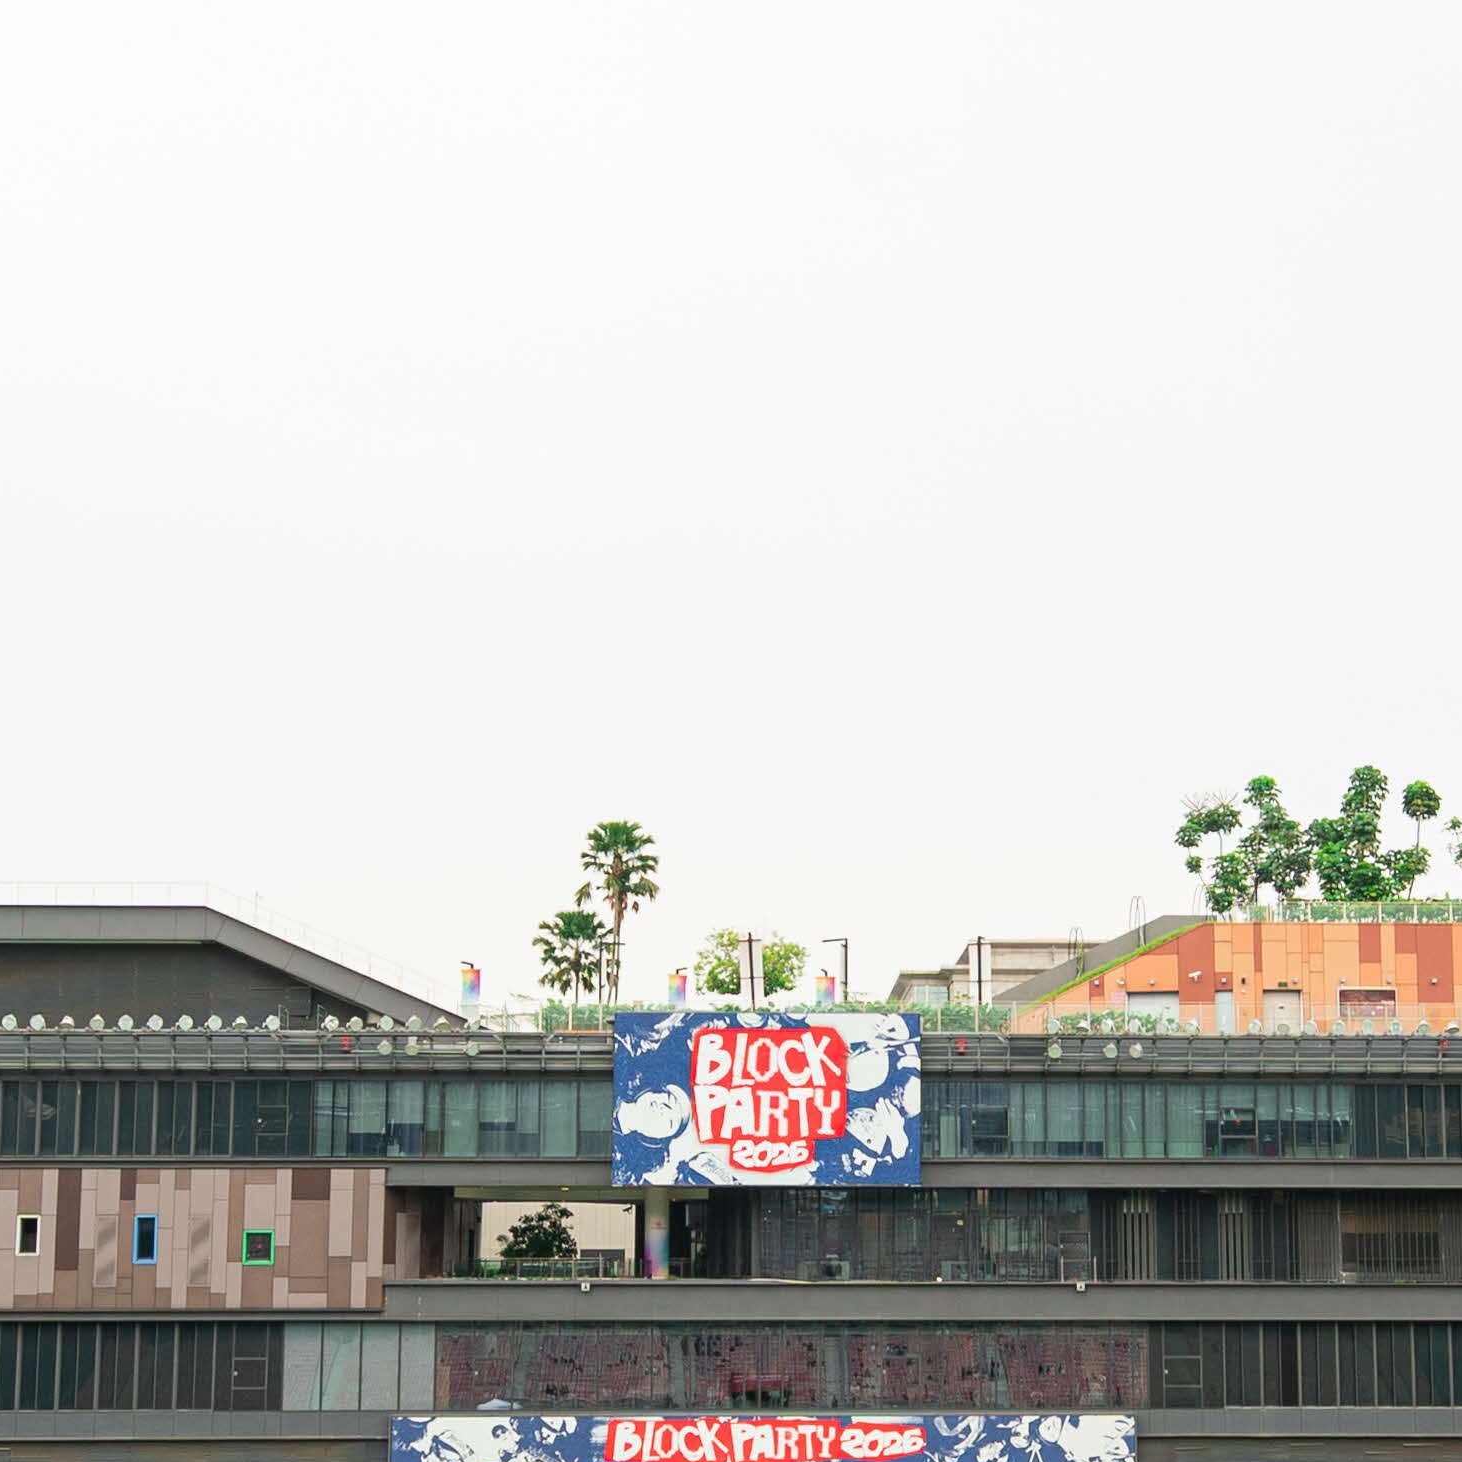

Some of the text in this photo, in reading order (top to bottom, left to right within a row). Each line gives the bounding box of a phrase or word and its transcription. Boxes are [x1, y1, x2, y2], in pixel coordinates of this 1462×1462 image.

[695, 1031, 842, 1087] BLOCK
[694, 1084, 841, 1142] PARTY
[731, 1140, 810, 1168] 2026
[612, 1419, 924, 1462] BLOCK PARTY 2026
